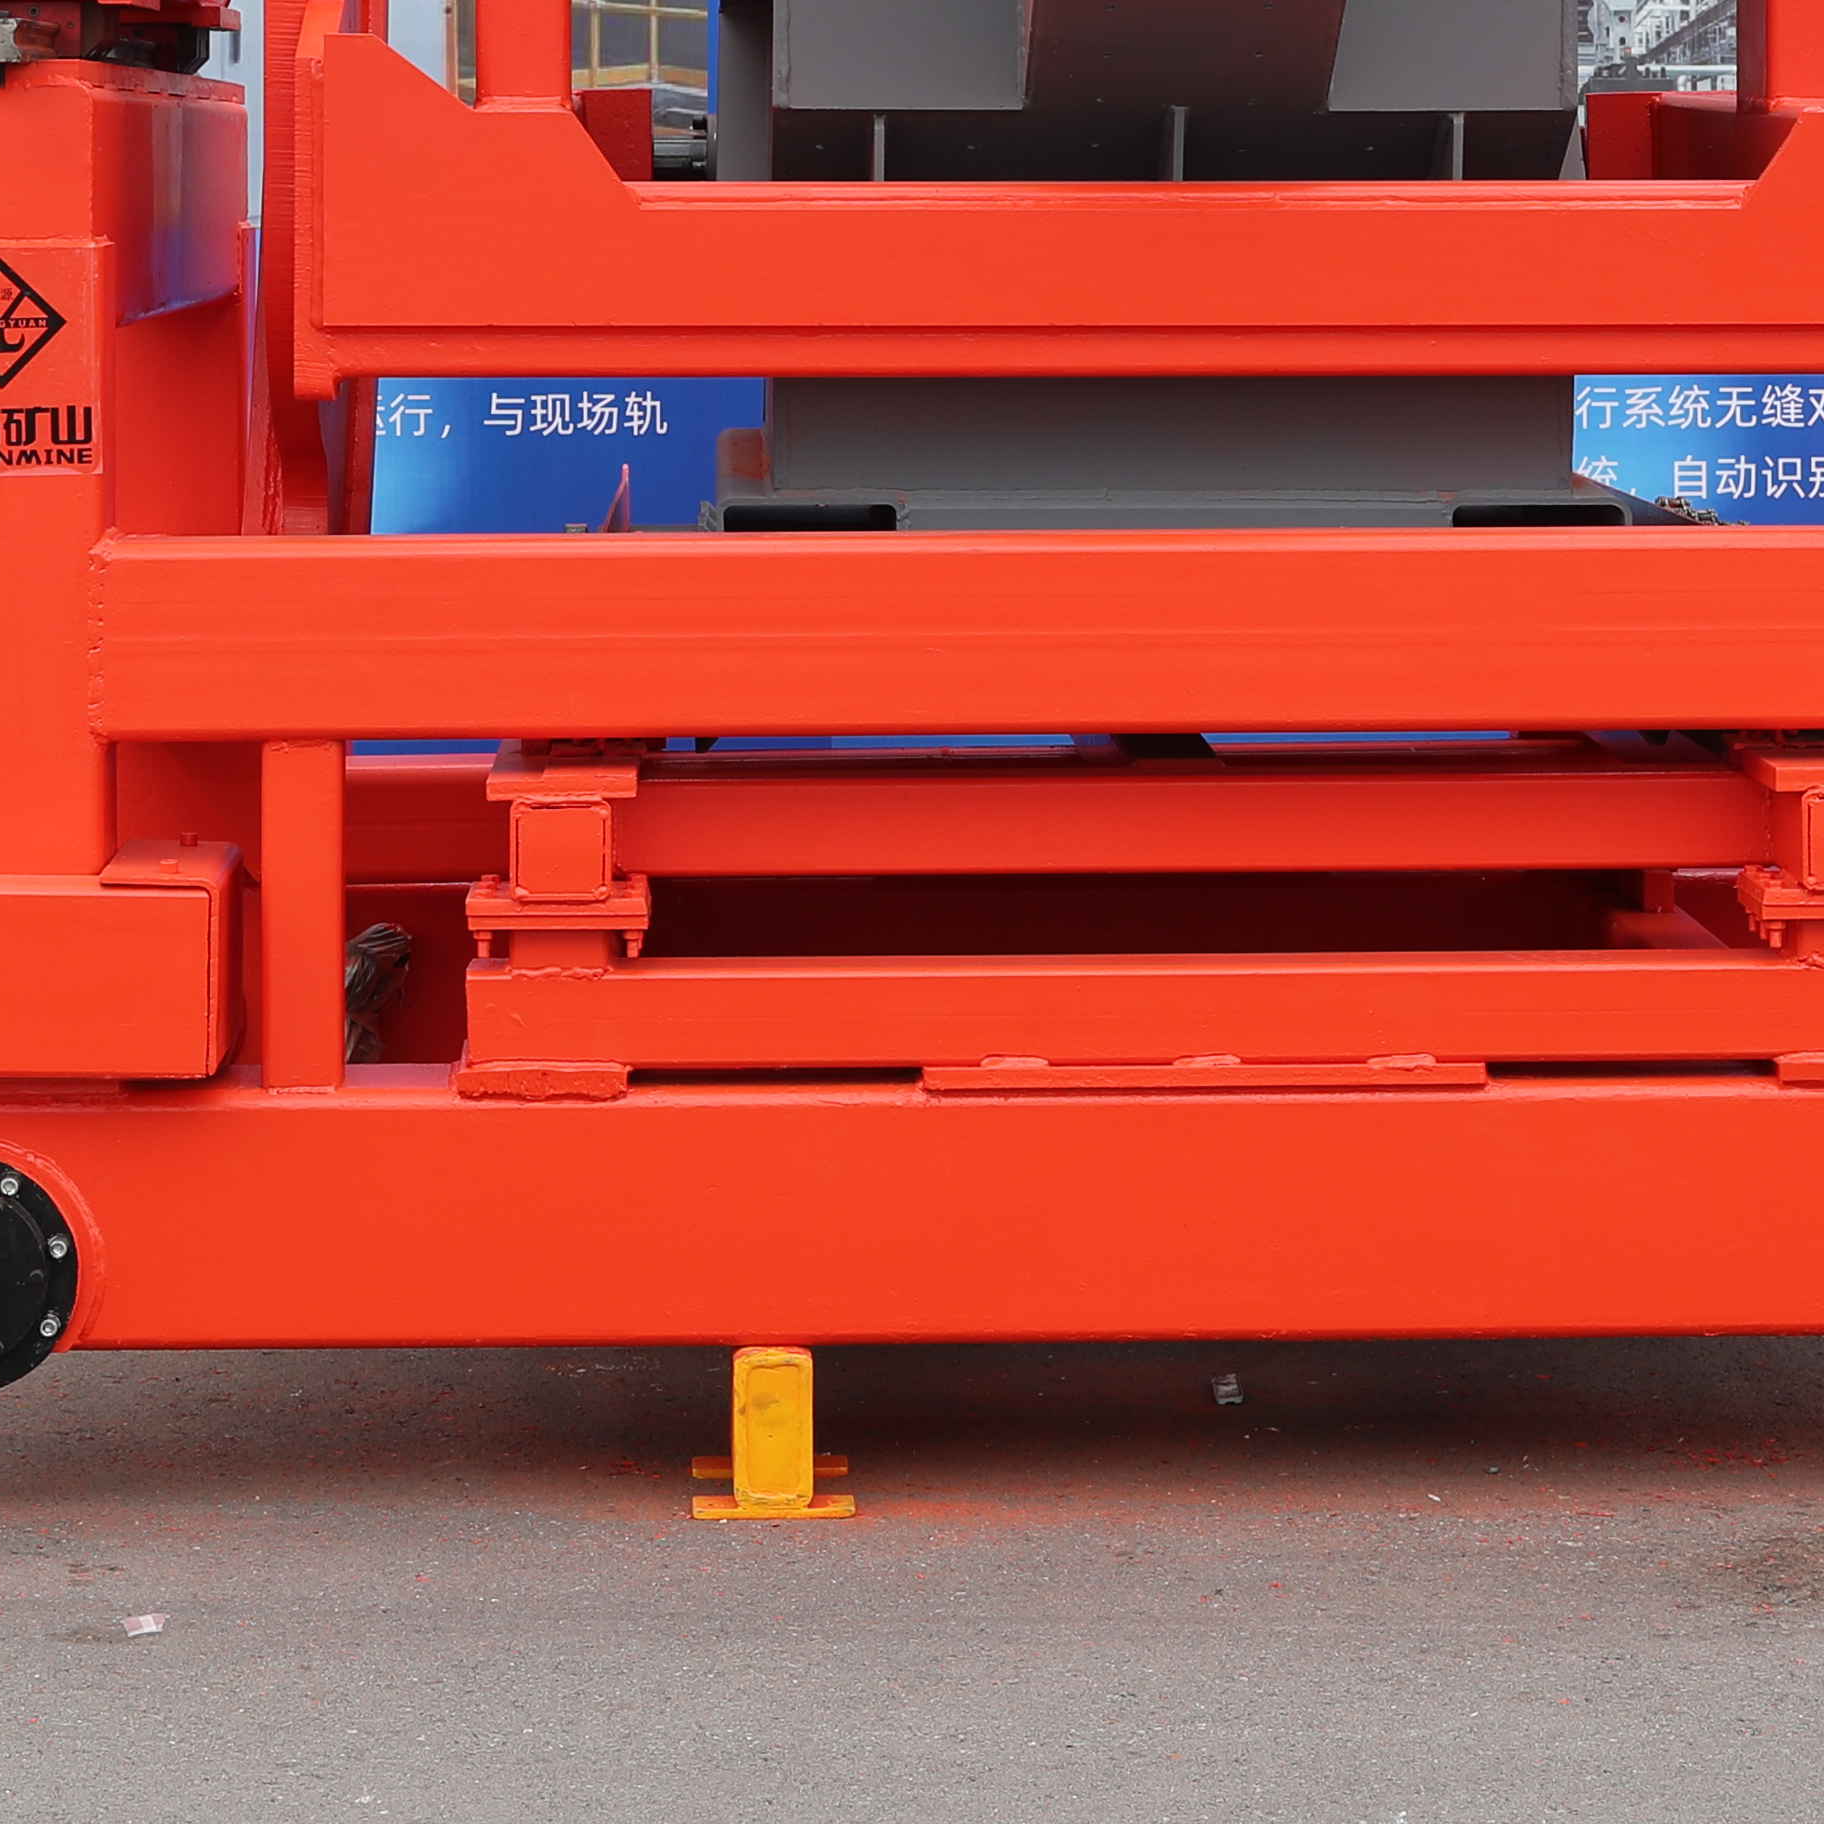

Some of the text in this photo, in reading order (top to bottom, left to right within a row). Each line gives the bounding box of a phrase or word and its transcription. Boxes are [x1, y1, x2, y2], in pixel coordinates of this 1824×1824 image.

[376, 390, 668, 439] 行，与现场轨
